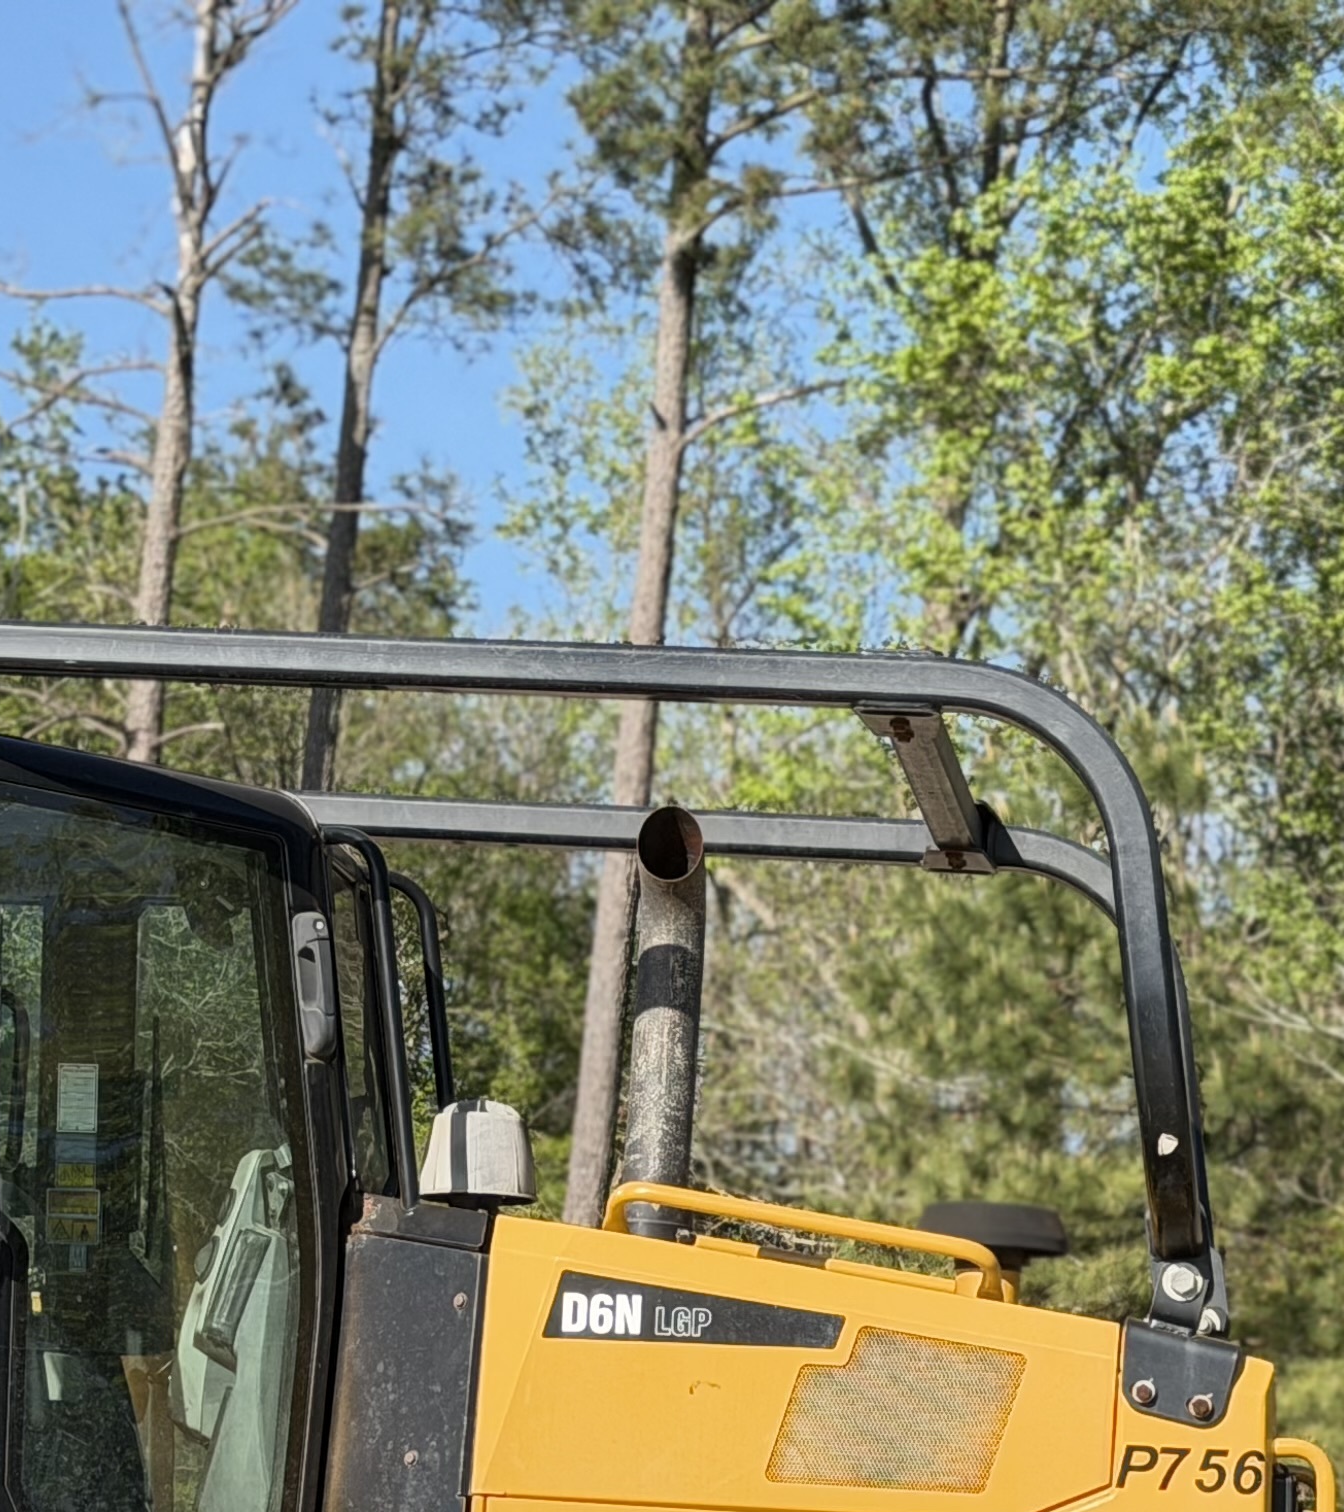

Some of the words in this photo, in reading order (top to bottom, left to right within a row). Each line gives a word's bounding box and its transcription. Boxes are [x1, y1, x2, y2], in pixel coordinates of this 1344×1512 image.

[561, 1292, 643, 1335] D6N
[654, 1306, 712, 1337] LGP
[1115, 1444, 1266, 1495] P756
